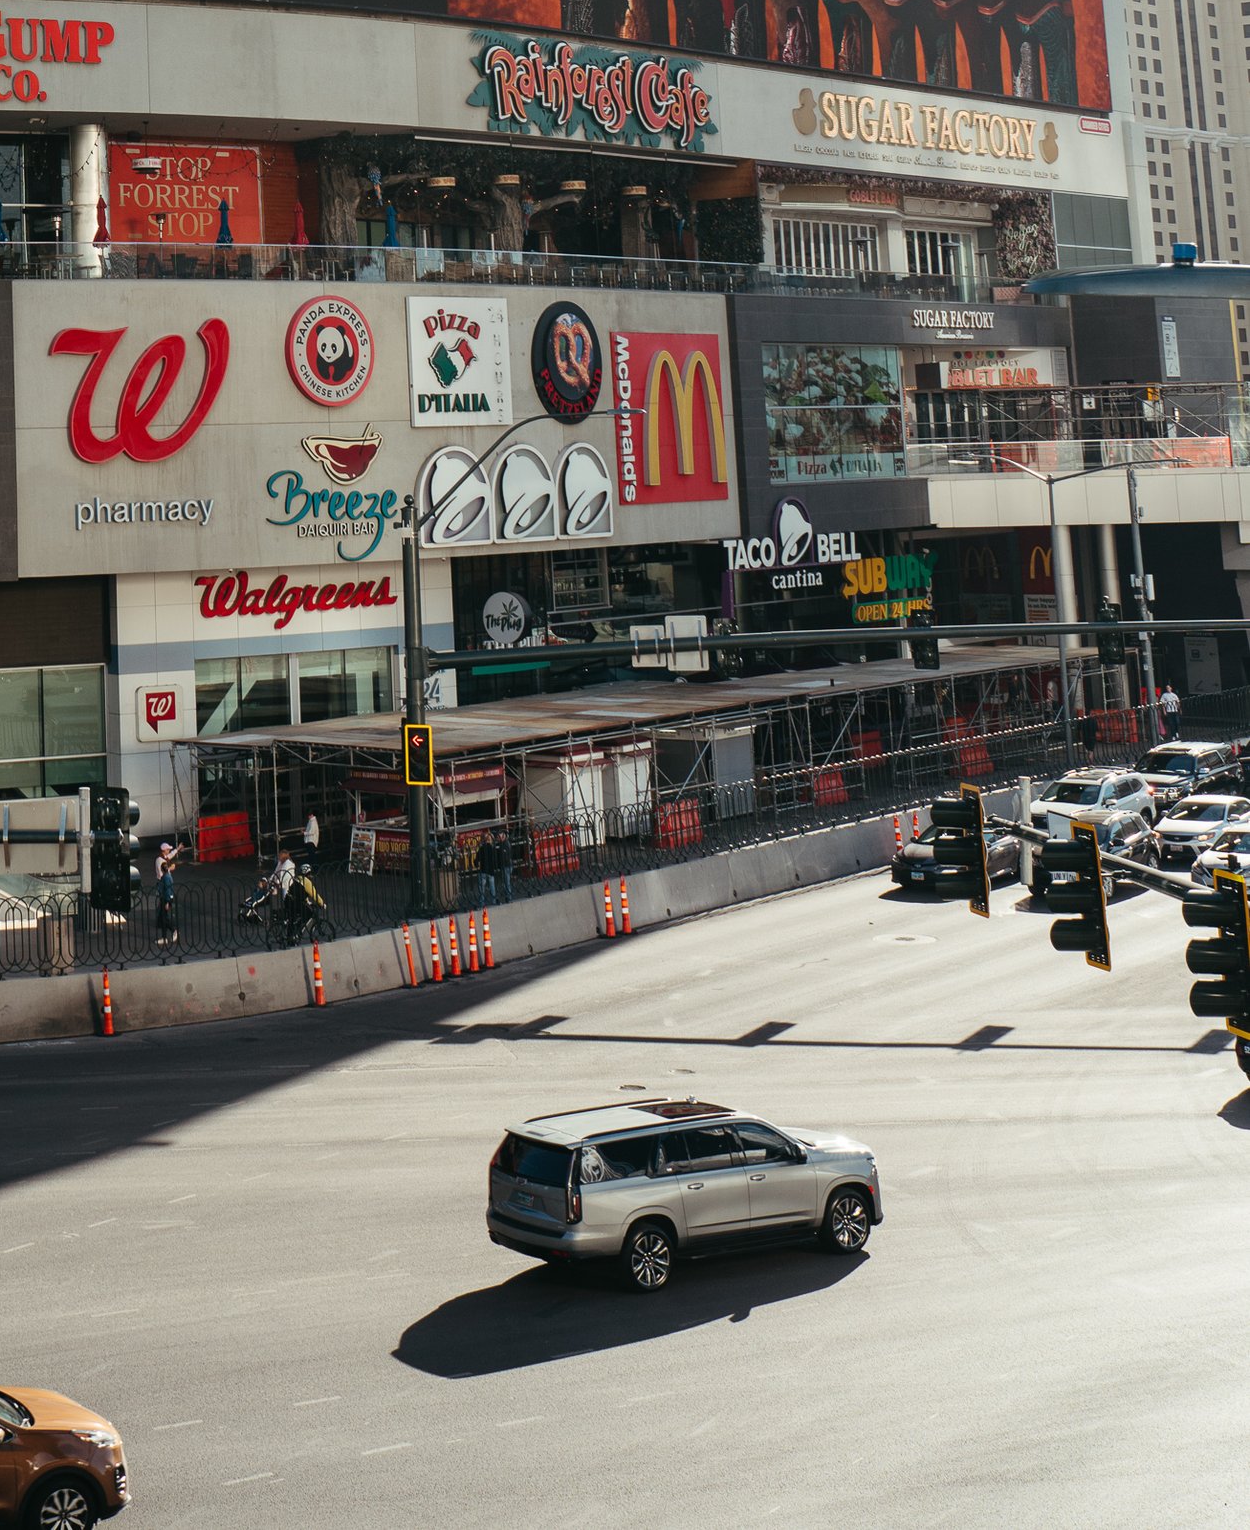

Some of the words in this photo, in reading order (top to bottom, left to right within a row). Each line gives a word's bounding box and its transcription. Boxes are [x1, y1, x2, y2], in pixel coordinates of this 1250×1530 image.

[485, 40, 633, 133] Rainforest
[635, 57, 710, 146] Cafe
[821, 91, 918, 147] SUGAR
[920, 104, 1037, 160] FACTORY
[118, 183, 239, 210] FORREST
[148, 212, 214, 237] STOP
[296, 306, 326, 345] PANDA
[329, 303, 368, 346] EXPRESS
[913, 309, 947, 327] SUGAR
[950, 311, 994, 329] FACTORY
[48, 318, 230, 463] W
[300, 364, 332, 398] CHINESE
[336, 365, 366, 398] KITCHEN
[541, 369, 602, 415] PRETZELAND
[948, 368, 995, 386] BLET
[1001, 368, 1038, 385] BAR
[417, 393, 491, 414] D'ITALIA
[614, 335, 638, 502] McDonald's
[797, 460, 827, 475] Pizza
[75, 498, 214, 530] pharmacy
[266, 470, 398, 561] Breeze
[297, 523, 349, 538] DAIQUIRI
[352, 522, 376, 536] BAR
[723, 538, 775, 570] TACO
[817, 532, 862, 563] BELL
[772, 570, 823, 590] cantina
[843, 553, 937, 599] SUBWAY
[194, 571, 397, 630] Walgreens
[857, 604, 888, 622] OPEN
[892, 601, 904, 618] 24
[424, 677, 442, 703] 24
